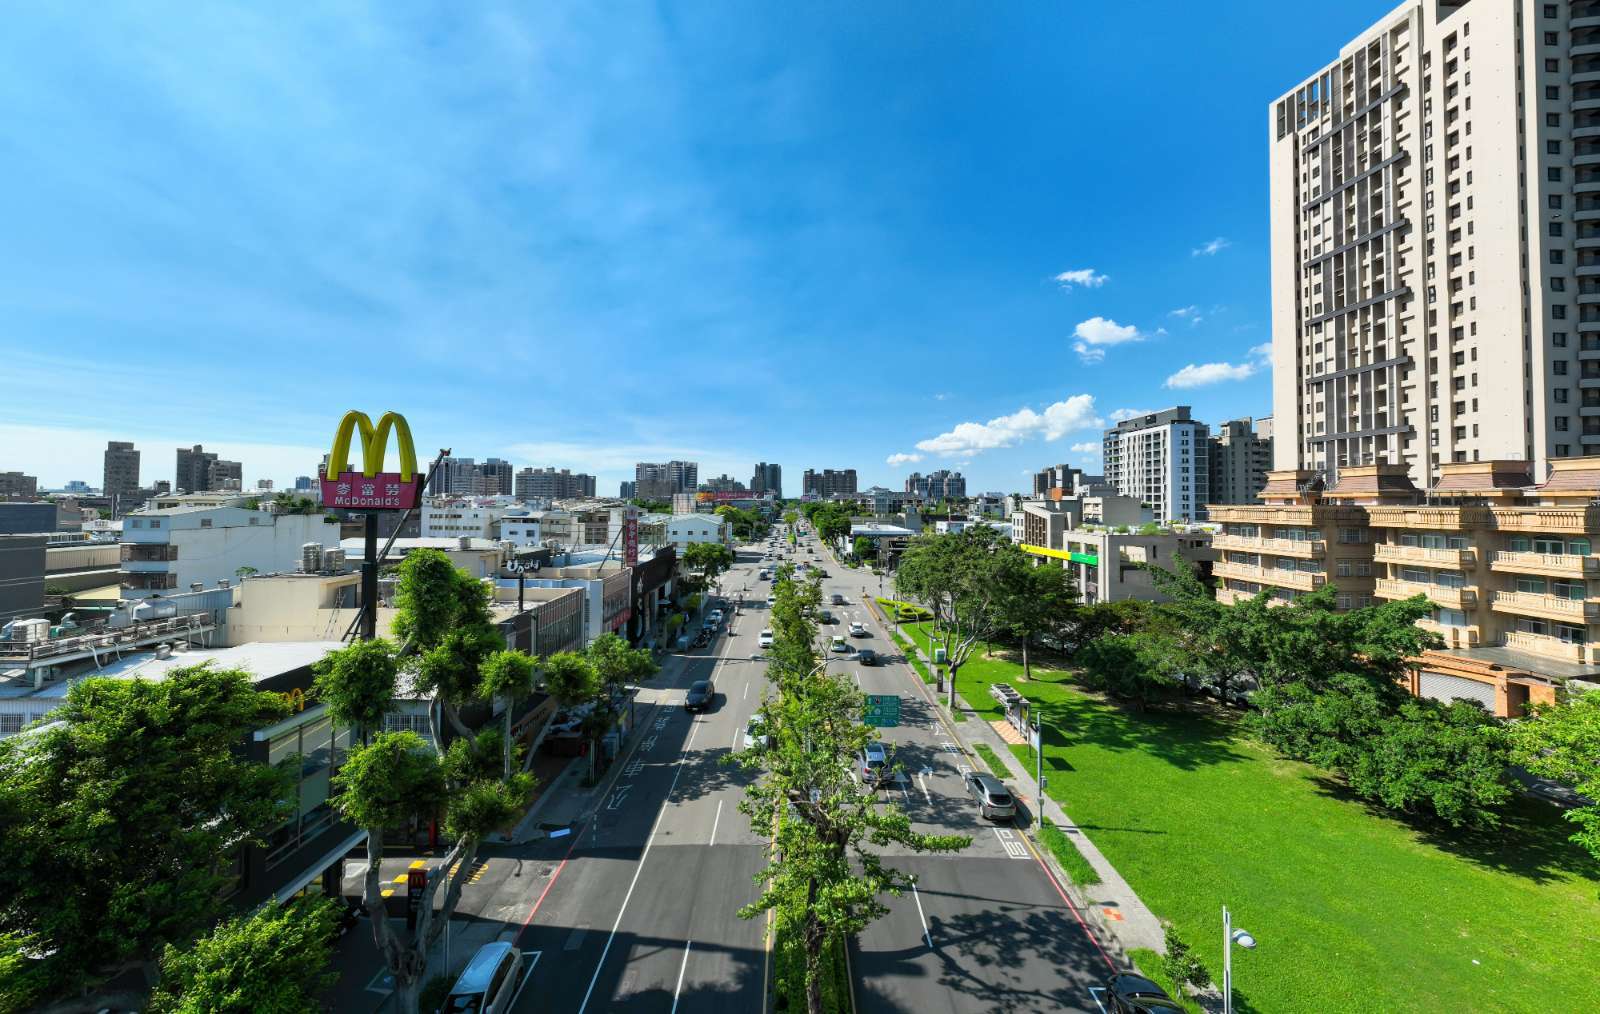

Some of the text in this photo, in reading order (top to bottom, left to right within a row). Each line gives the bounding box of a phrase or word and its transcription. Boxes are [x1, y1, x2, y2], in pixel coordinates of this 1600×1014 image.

[336, 483, 400, 495] 麥當勞
[335, 496, 400, 506] McDonald's
